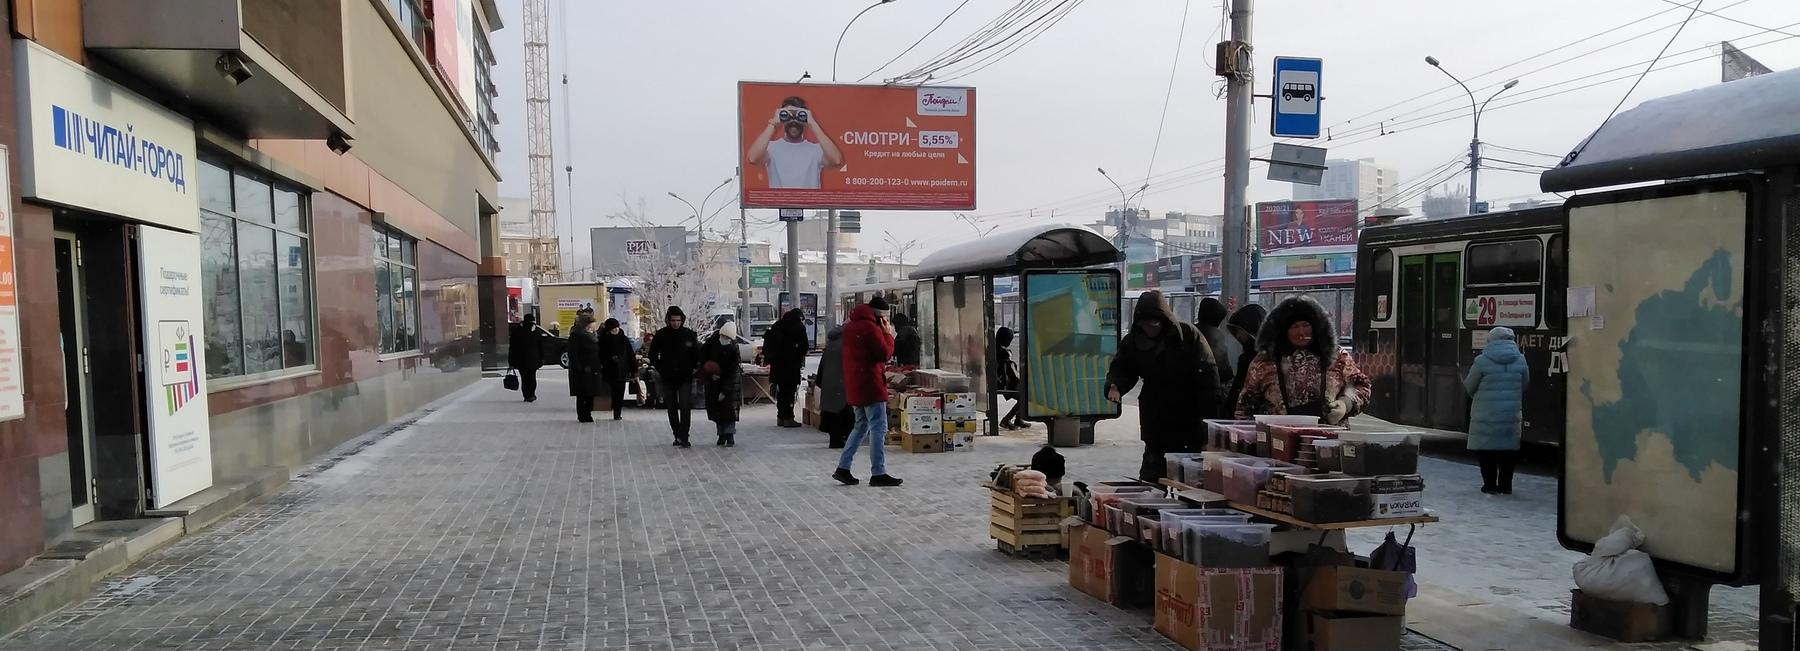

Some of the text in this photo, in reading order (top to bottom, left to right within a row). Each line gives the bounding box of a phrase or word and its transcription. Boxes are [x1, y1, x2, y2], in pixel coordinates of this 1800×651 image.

[85, 118, 186, 194] ЧИТАЙ-ГОРОД
[864, 150, 890, 158] Кредит
[901, 151, 926, 159] любые
[927, 152, 946, 160] цели
[845, 177, 968, 187] 8 800-200-123-0 www.poidem.ru
[1267, 228, 1316, 245] NEW
[1478, 296, 1496, 325] 29
